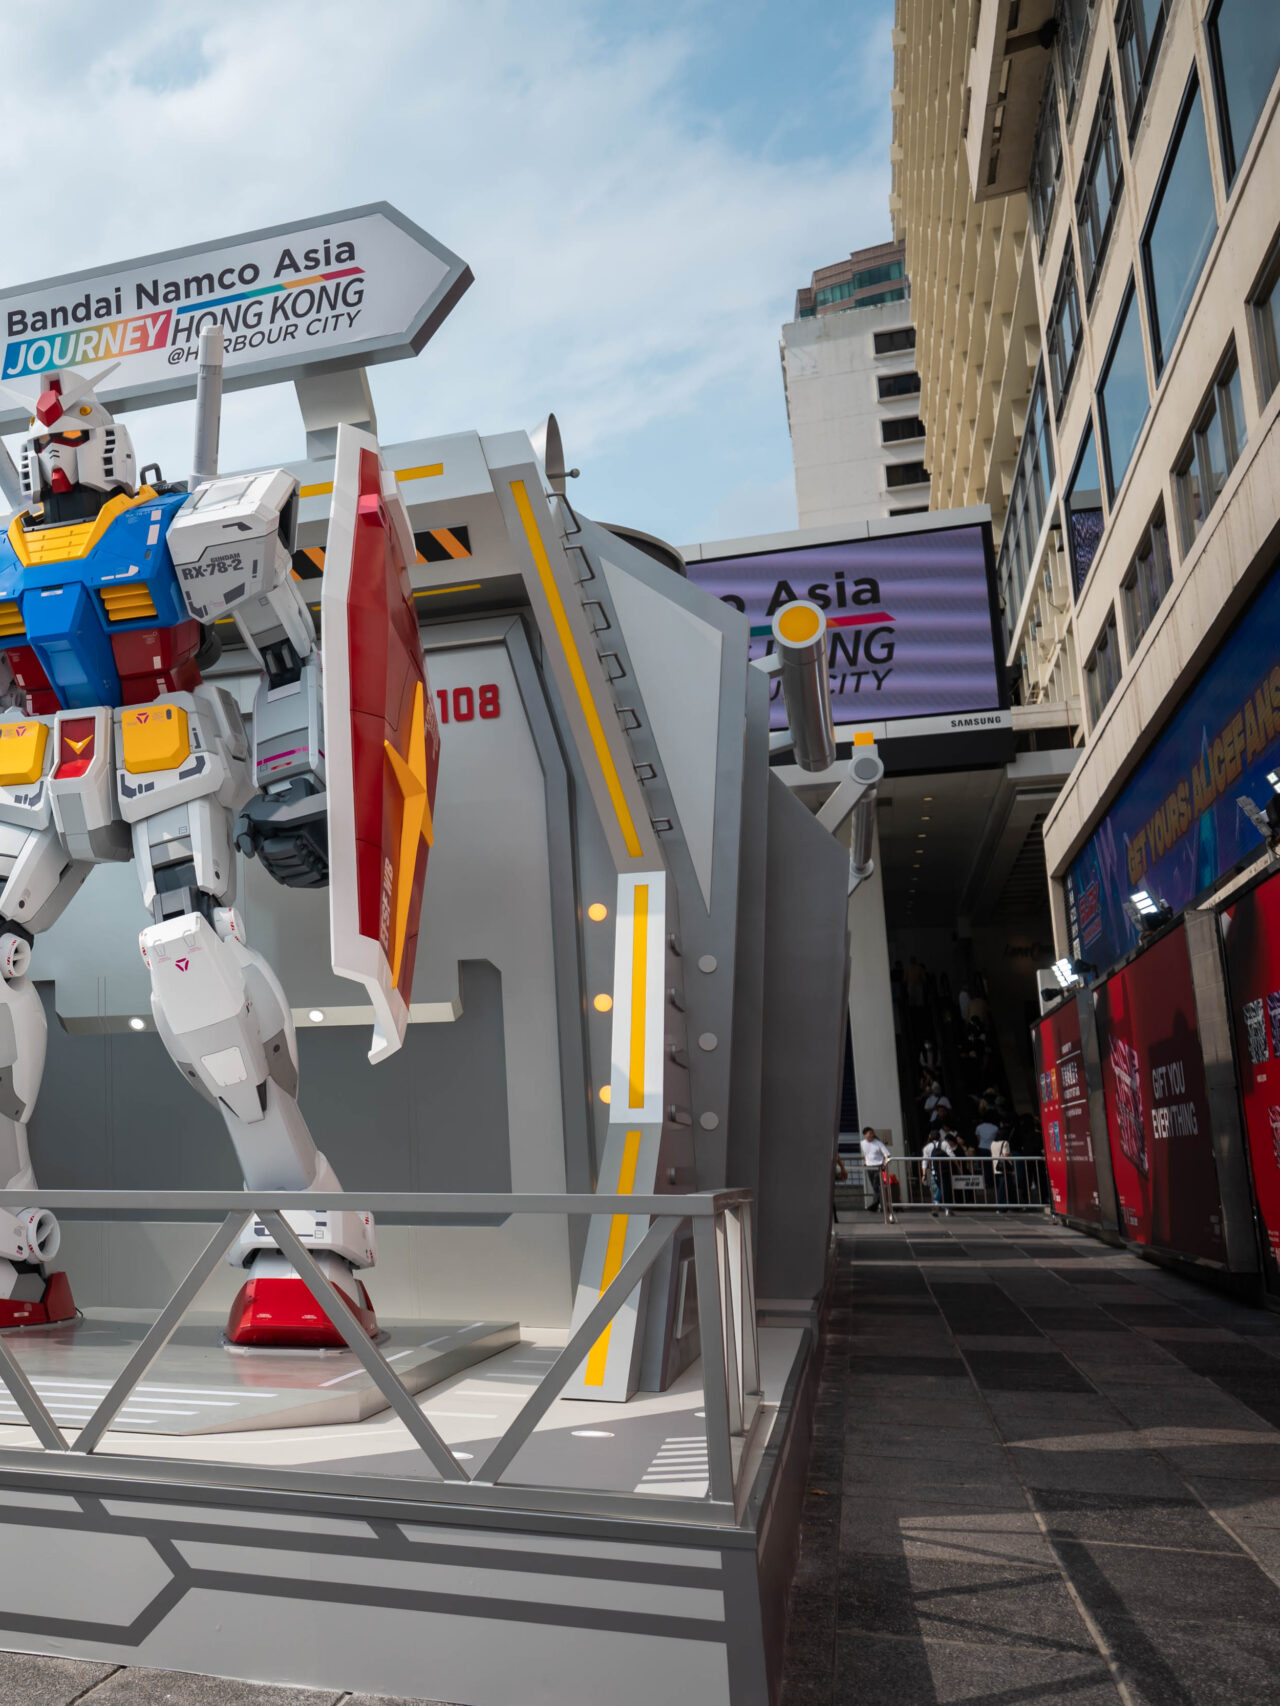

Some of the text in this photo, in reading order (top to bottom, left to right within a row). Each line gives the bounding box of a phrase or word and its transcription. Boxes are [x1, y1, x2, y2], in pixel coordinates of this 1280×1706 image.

[7, 238, 356, 338] Bandai Namco Asia
[6, 277, 365, 376] JOURNEY HONG KONG
[167, 309, 362, 365] @HRBOUR CITY
[181, 559, 244, 581] RX-78-2
[210, 552, 241, 564] GUNDAM
[765, 571, 882, 617] Asia
[436, 683, 501, 724] 108
[951, 715, 1001, 728] SAMSUNG
[1152, 1060, 1186, 1100] GIFT YOU
[1151, 1101, 1199, 1139] EVERYTHING
